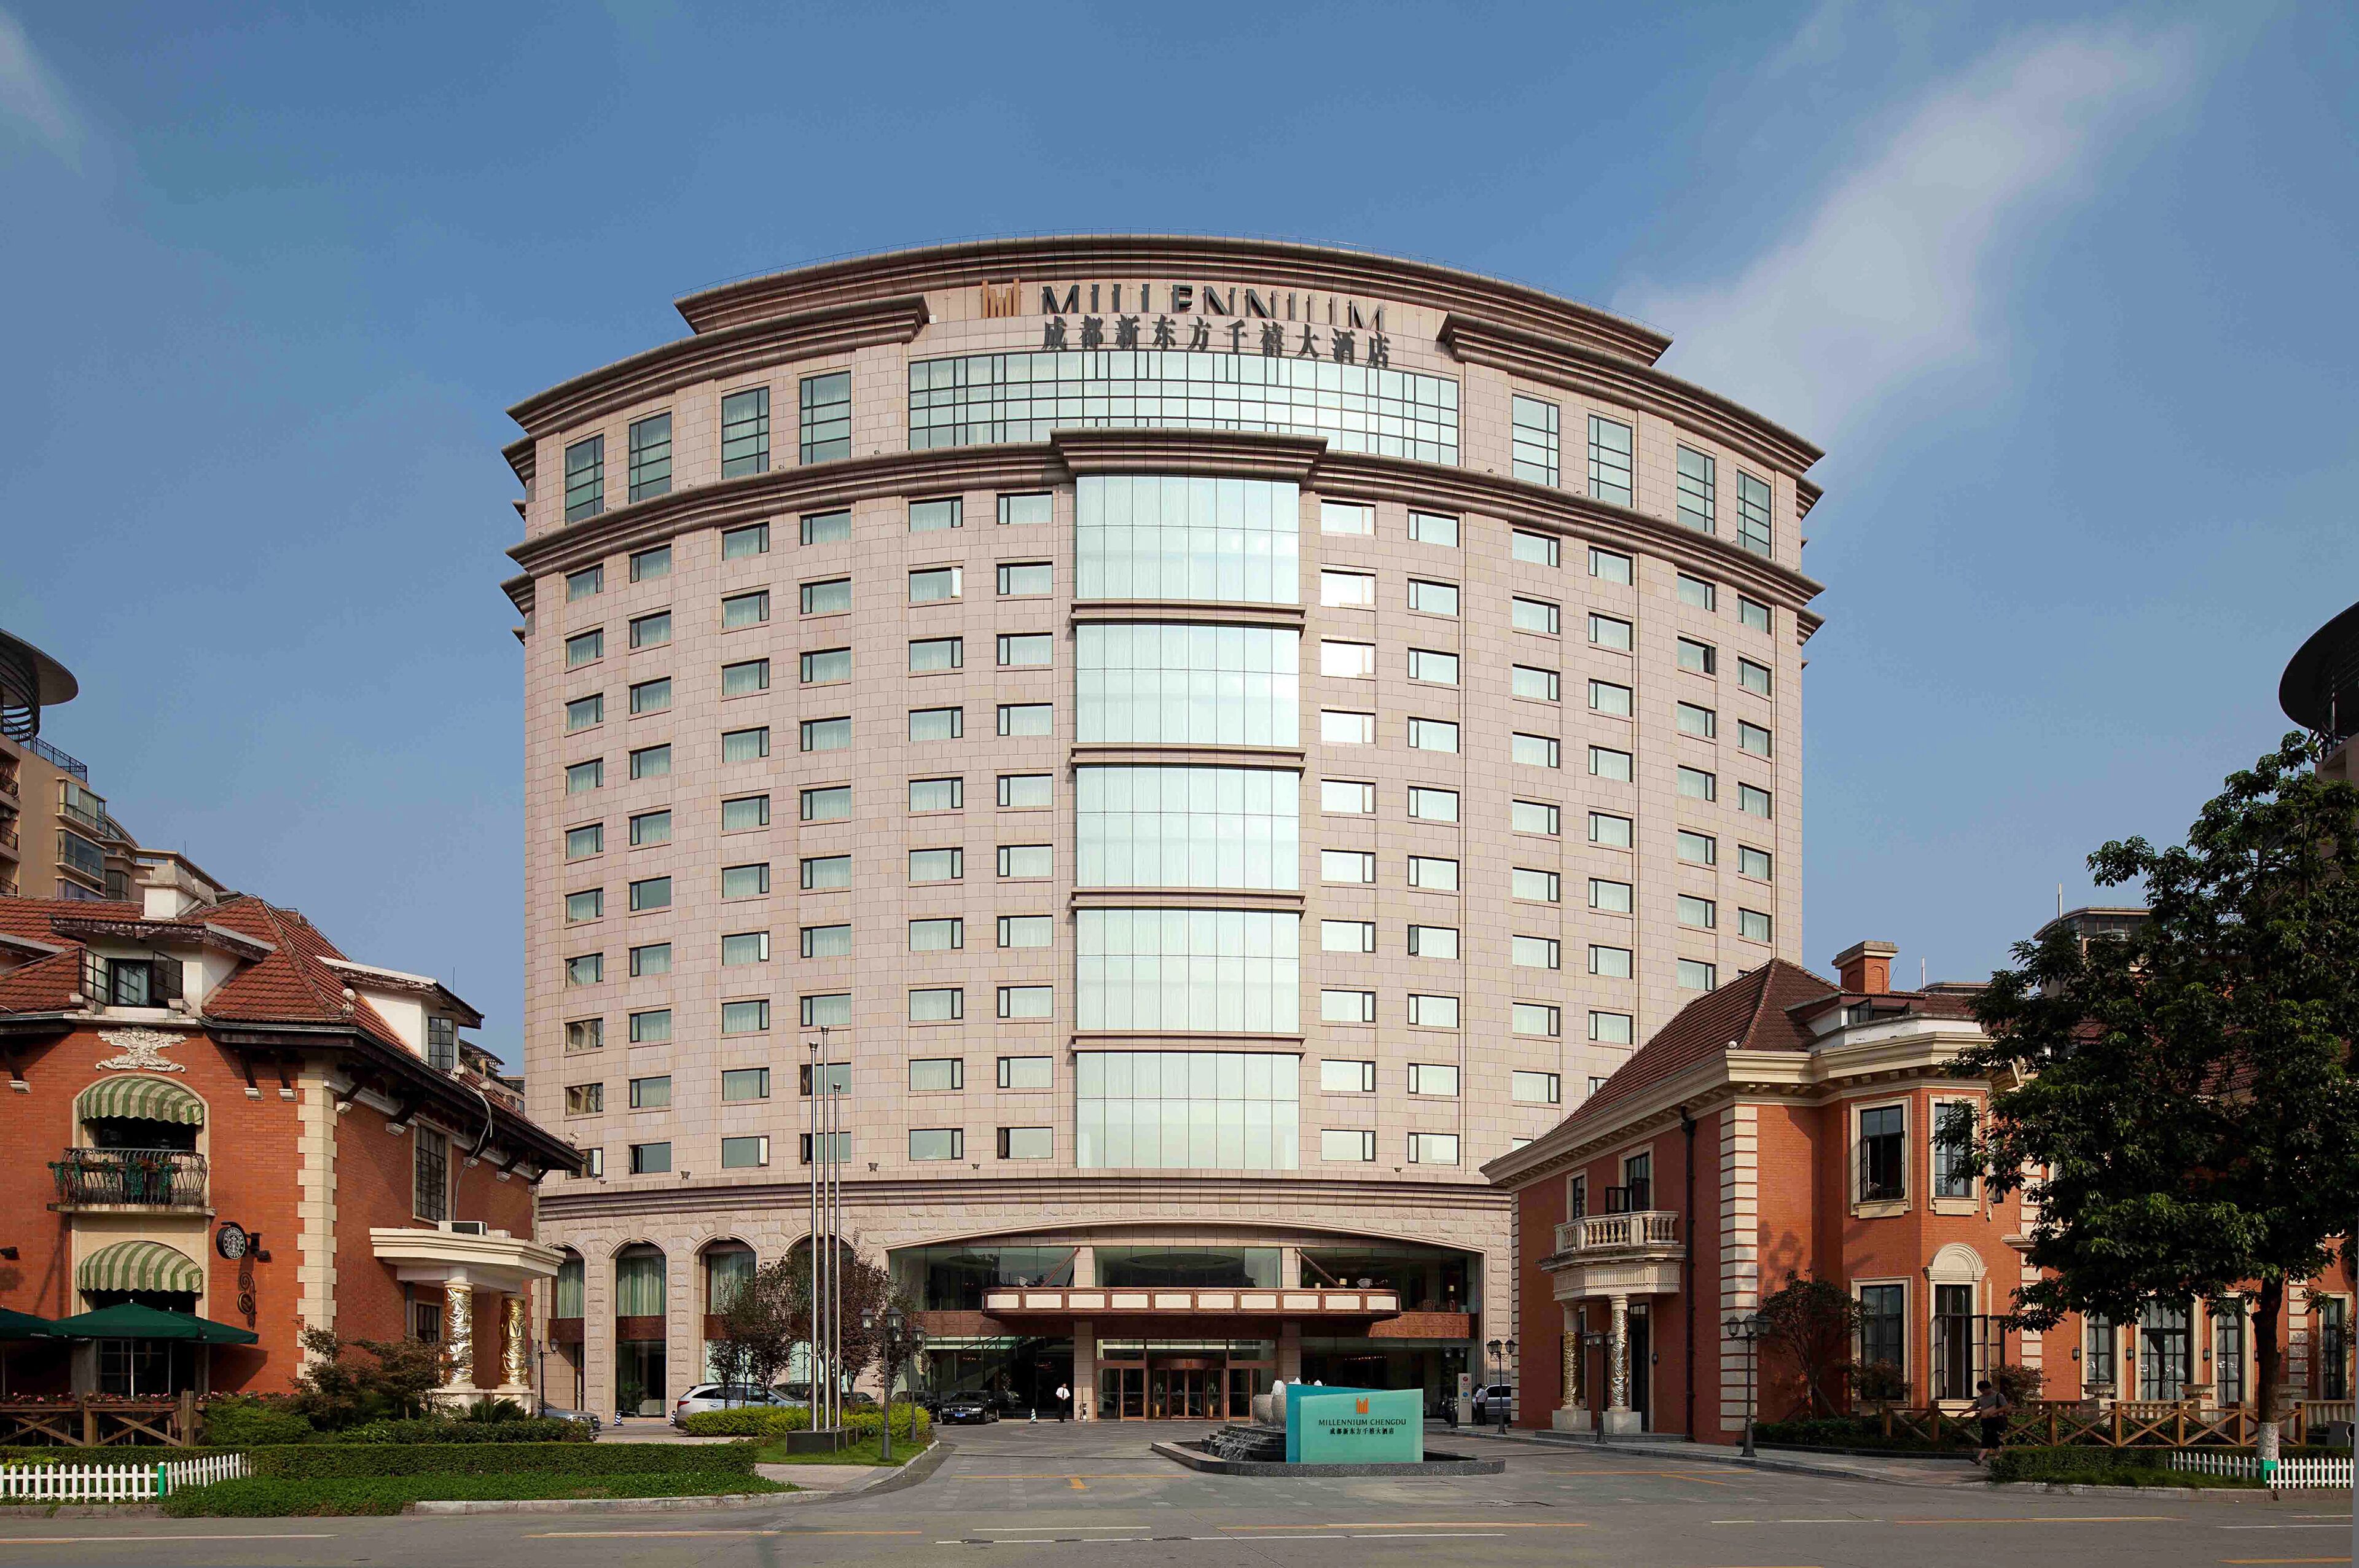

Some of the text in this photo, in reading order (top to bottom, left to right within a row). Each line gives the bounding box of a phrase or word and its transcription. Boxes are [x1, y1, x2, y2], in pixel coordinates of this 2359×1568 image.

[1041, 313, 1390, 369] 成都新东方千禧大酒店
[224, 1229, 243, 1245] STARBUCKS
[226, 1248, 241, 1258] COFFEE
